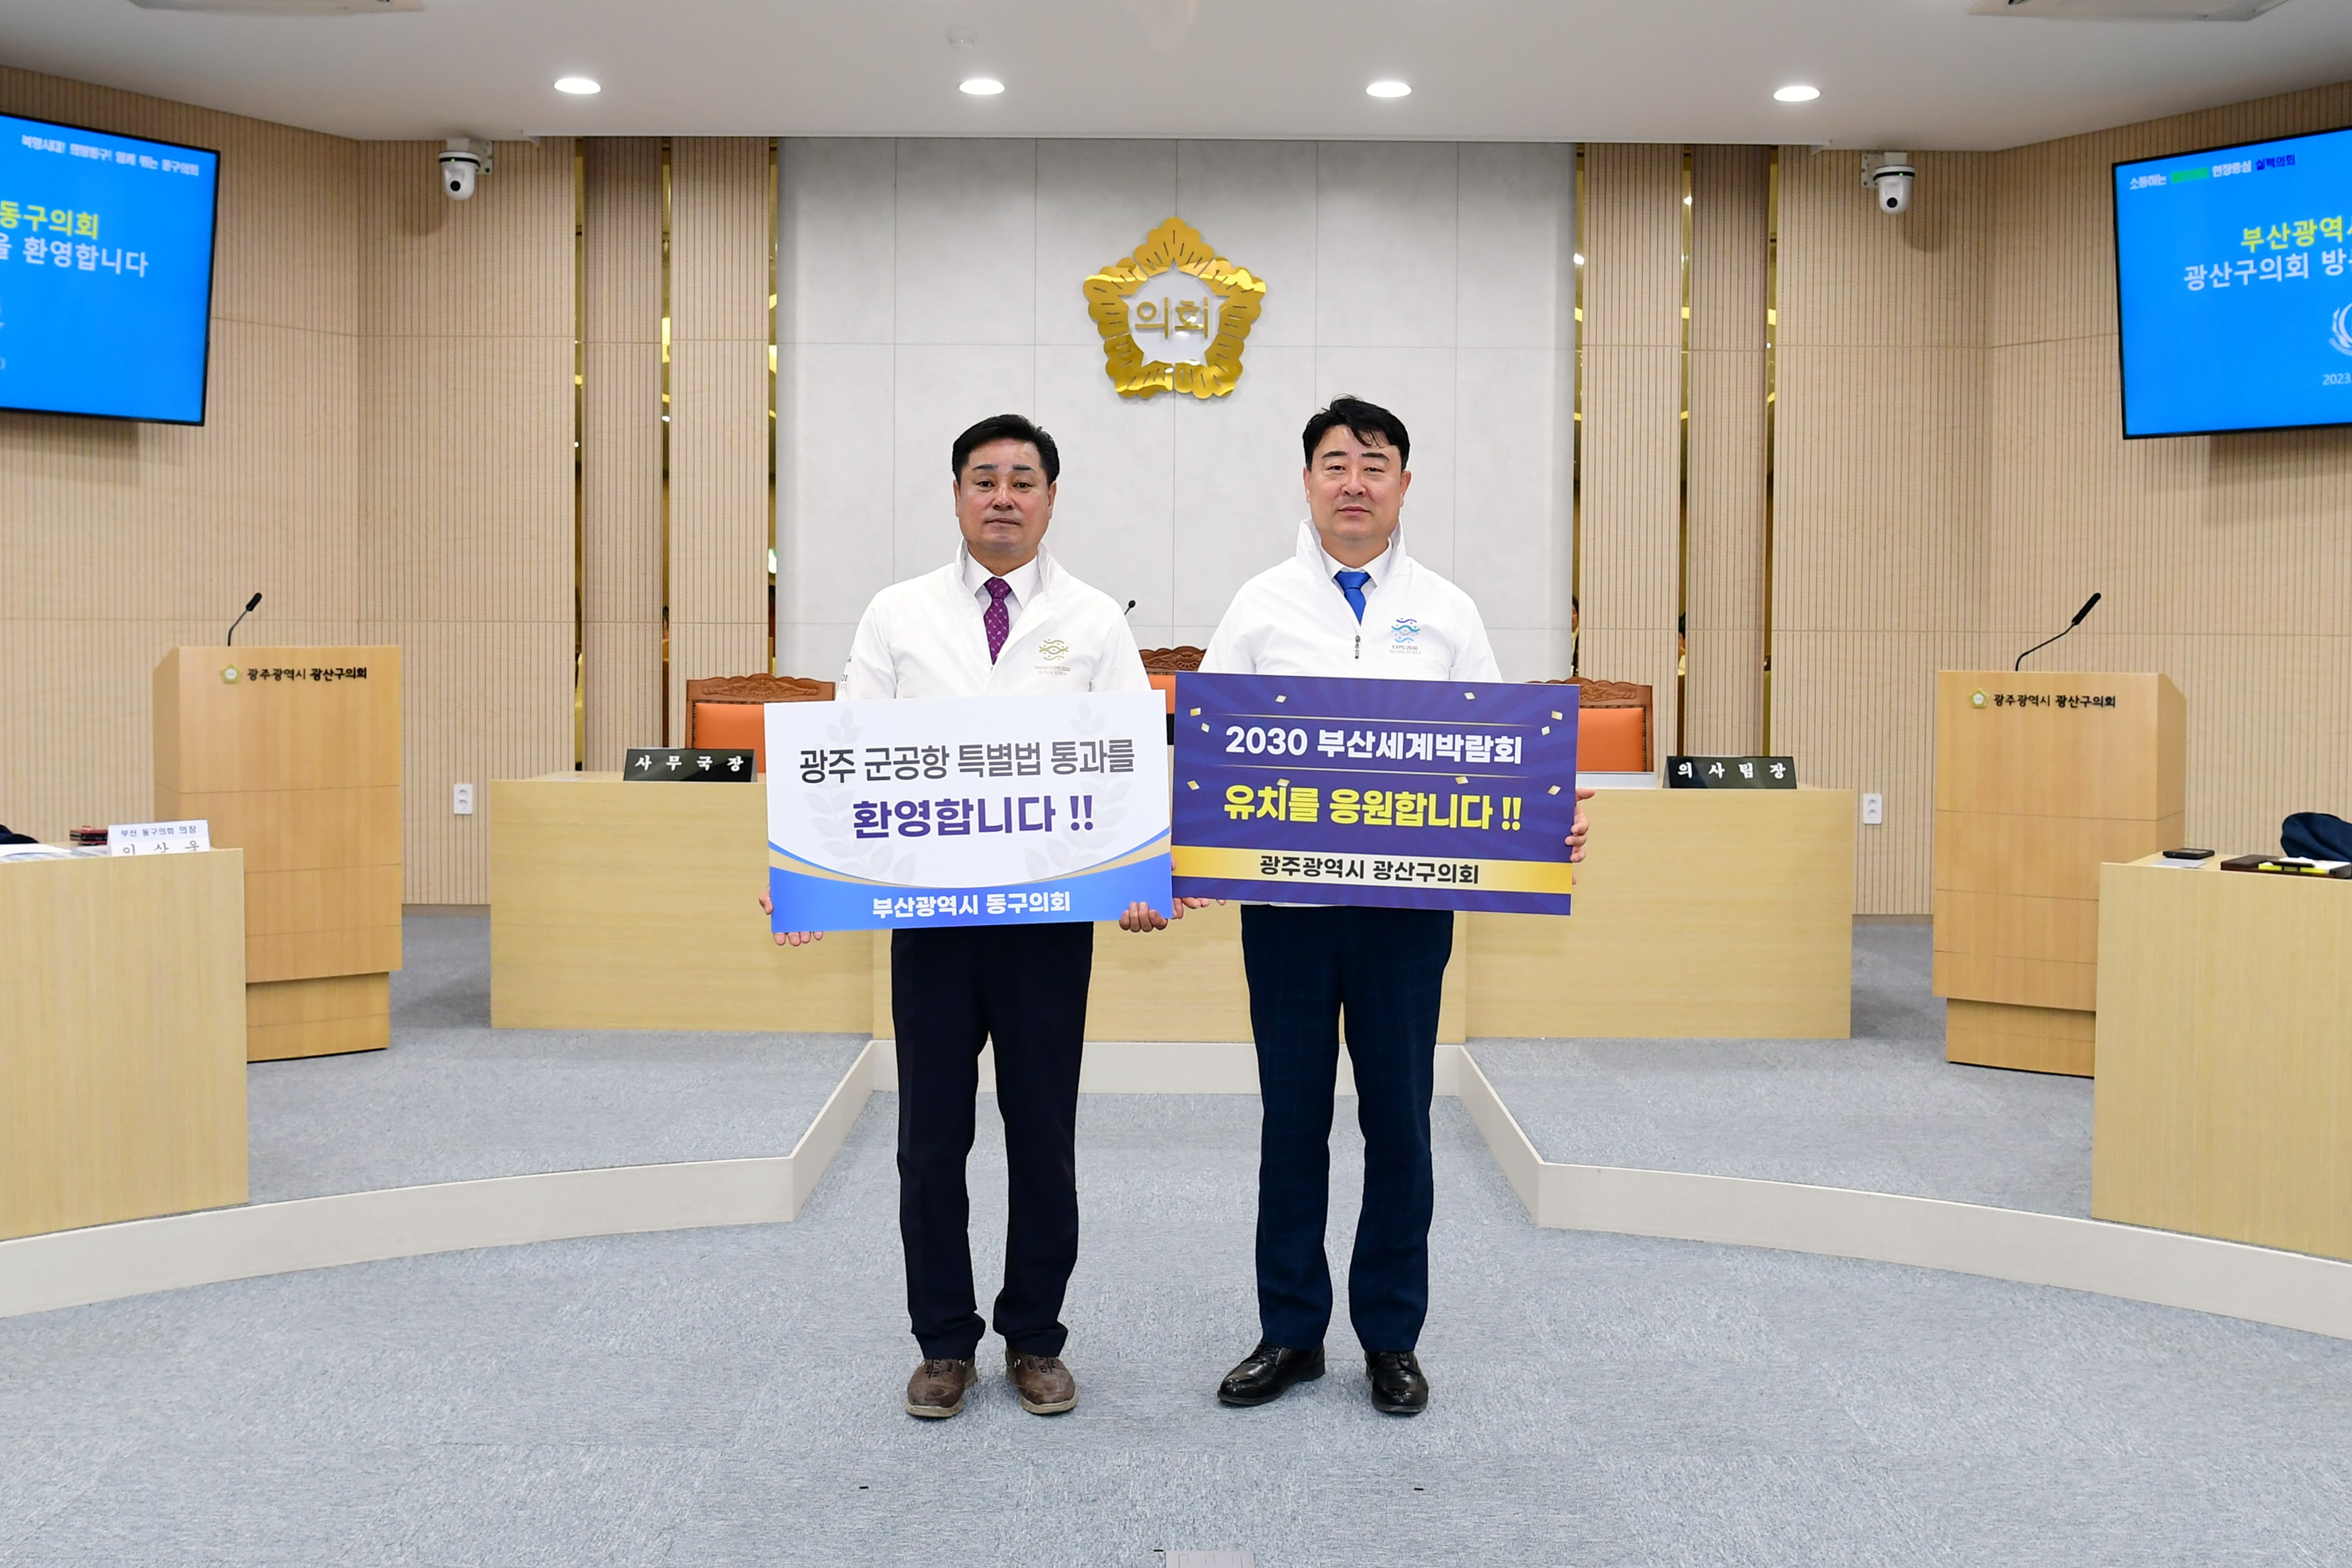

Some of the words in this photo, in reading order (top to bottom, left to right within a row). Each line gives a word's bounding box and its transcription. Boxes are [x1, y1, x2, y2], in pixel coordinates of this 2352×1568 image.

[0, 200, 99, 239] 동구의회
[23, 237, 148, 277] 환영합니다
[2184, 252, 2309, 291] 광산구의회
[2322, 248, 2352, 276] 방
[1135, 297, 1209, 339] 의회
[247, 668, 306, 681] 광주광역시
[309, 667, 367, 682] 광산구의회
[1994, 694, 2051, 707] 광주광역시
[2055, 695, 2116, 709] 광산구의회
[799, 749, 856, 784] 광주
[864, 745, 950, 782] 군공항
[958, 742, 1041, 778] 특별법
[1050, 739, 1135, 775] 통과를
[1225, 726, 1308, 756] 2030
[1318, 730, 1522, 764] 부산세계박람회
[852, 796, 1056, 839] 환영합니다
[1069, 795, 1094, 831] !!
[1224, 784, 1320, 823] 유치를
[1329, 789, 1494, 830] 응원합니다
[1501, 796, 1522, 831] !!
[142, 827, 174, 836] 동구의회
[179, 826, 196, 834] 의장
[1259, 855, 1365, 879] 광주광역시
[1373, 862, 1479, 884] 광산구의회
[872, 897, 979, 919] 부산광역시
[986, 892, 1071, 914] 동구의회
